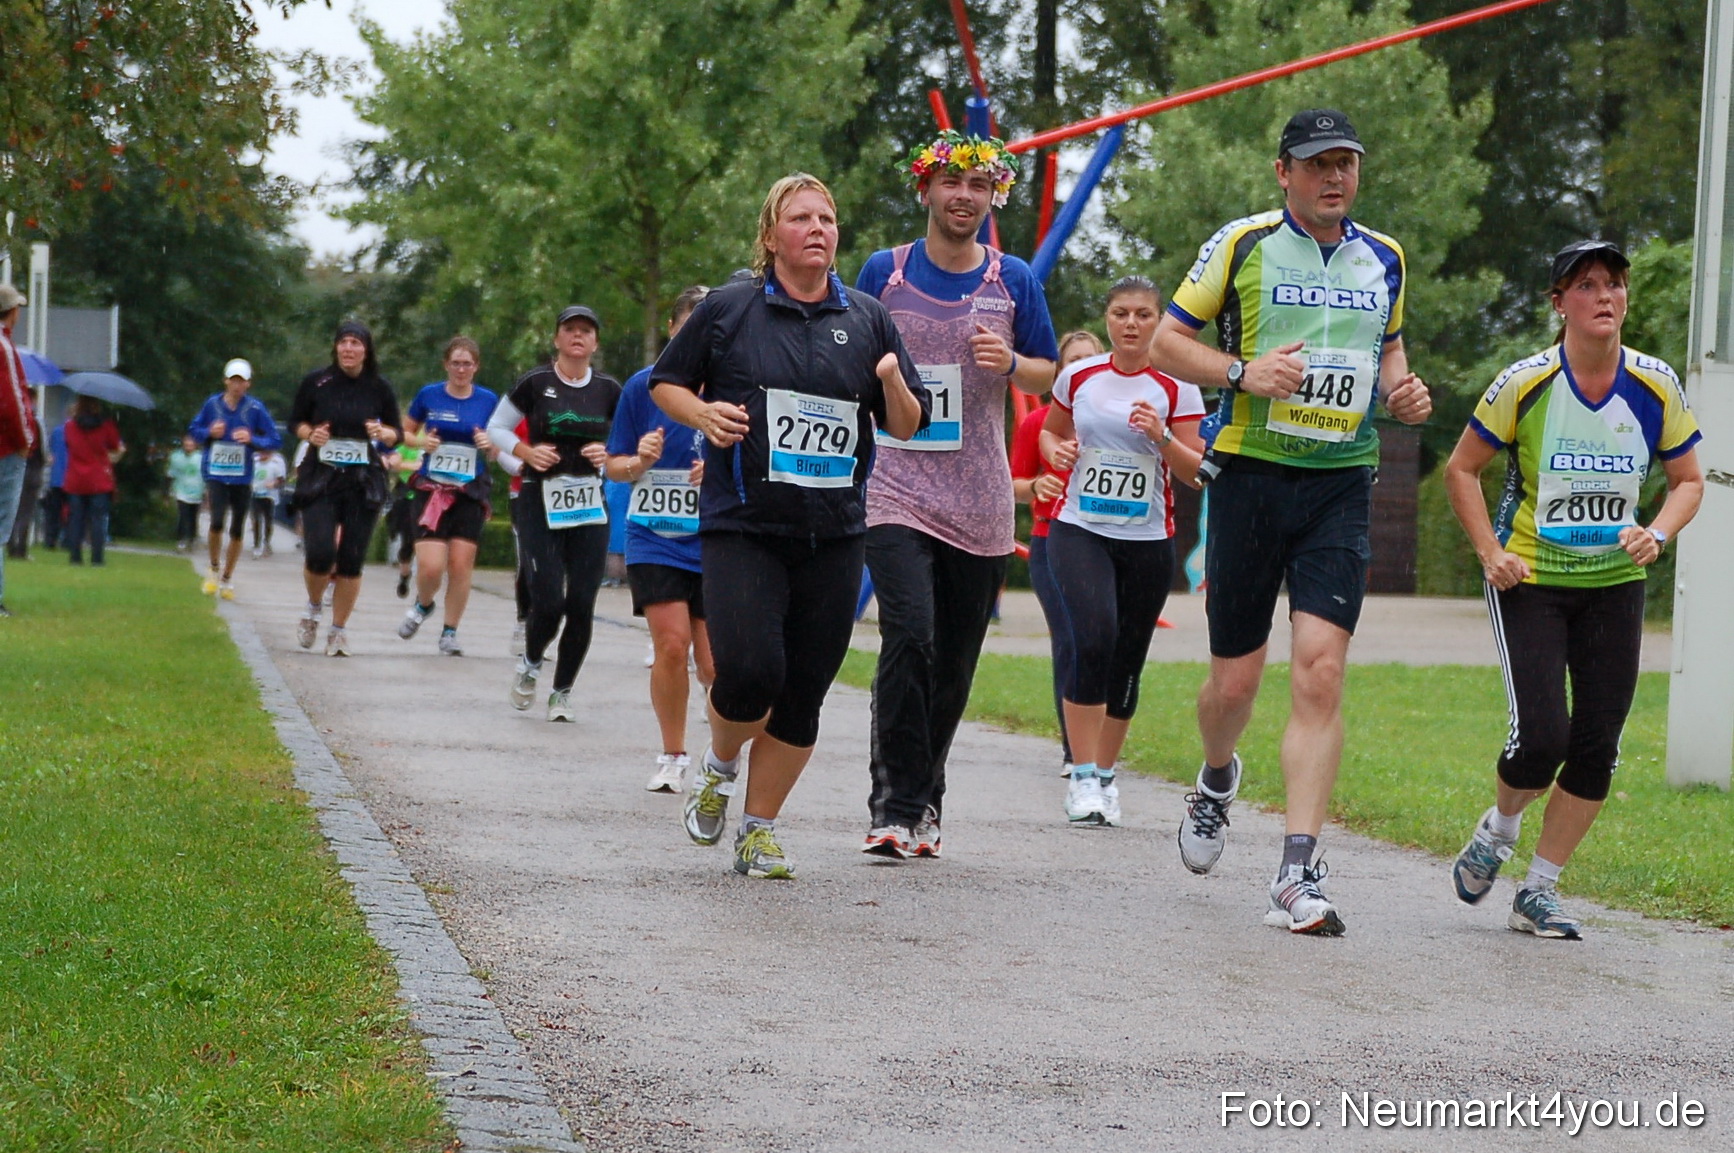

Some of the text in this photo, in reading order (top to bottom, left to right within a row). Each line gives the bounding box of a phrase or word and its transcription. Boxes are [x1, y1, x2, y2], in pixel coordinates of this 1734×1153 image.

[1276, 266, 1342, 285] TEAM
[1272, 284, 1377, 311] BOCK
[1289, 408, 1348, 433] Wolfgang
[776, 415, 850, 454] 2729
[1556, 438, 1607, 453] TEAM
[434, 455, 470, 473] 2711
[796, 458, 831, 477] Birgit
[1550, 452, 1635, 473] BOCK
[1083, 466, 1147, 499] 2679
[1571, 480, 1610, 491] BOCK
[551, 486, 595, 510] 2647
[637, 488, 699, 515] 2969
[1546, 494, 1627, 523] 2800
[1570, 530, 1603, 544] Heidi
